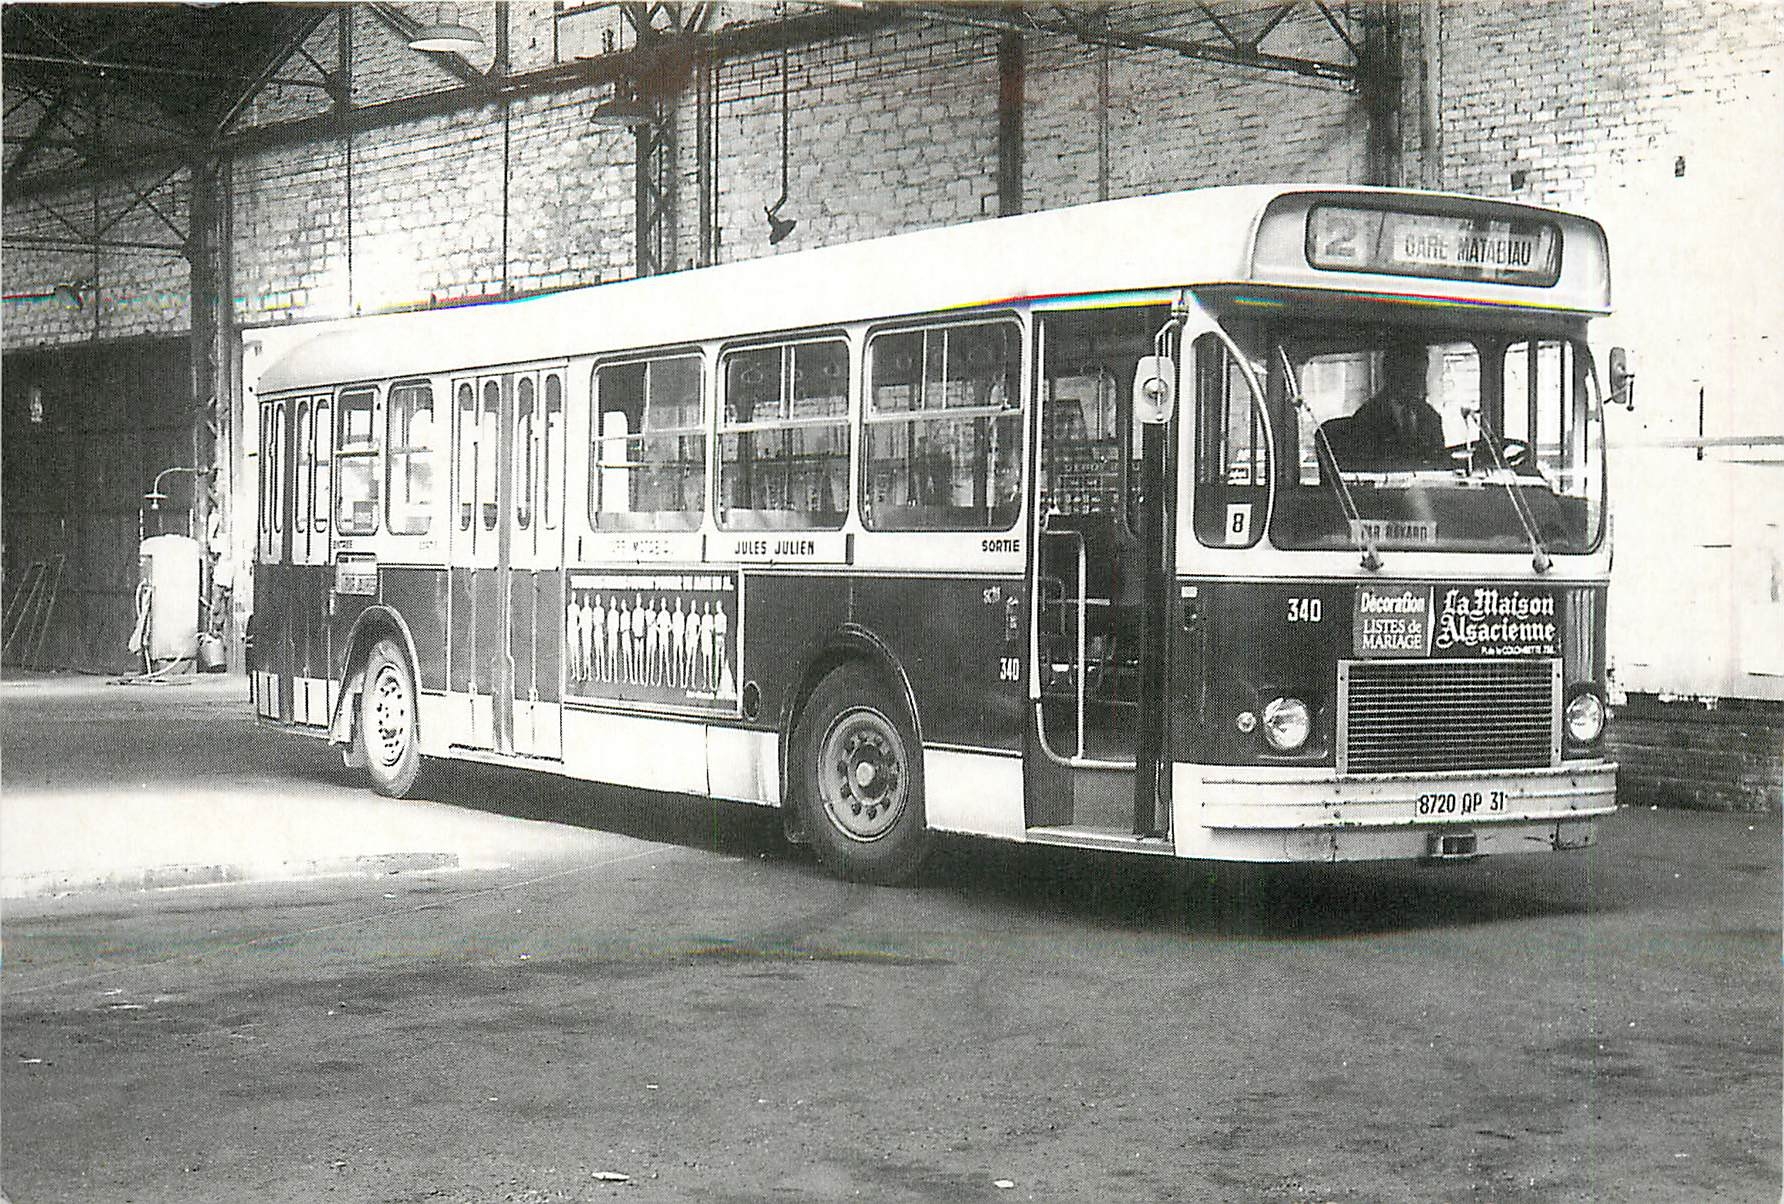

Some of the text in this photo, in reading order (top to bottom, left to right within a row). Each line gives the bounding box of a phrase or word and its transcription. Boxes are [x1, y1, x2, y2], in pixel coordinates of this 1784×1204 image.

[1326, 217, 1357, 257] 2
[1232, 512, 1244, 533] 8
[734, 540, 815, 555] JULES JULIEN
[981, 539, 1020, 552] SORTIE
[1287, 598, 1322, 622] 340
[1442, 587, 1555, 621] La Maison
[1363, 618, 1422, 634] LISTES de
[1436, 614, 1556, 649] Alsacienne
[1362, 633, 1422, 650] MARIAGE
[999, 657, 1020, 681] 340
[1419, 793, 1456, 815] 8720
[1490, 791, 1504, 811] 31
